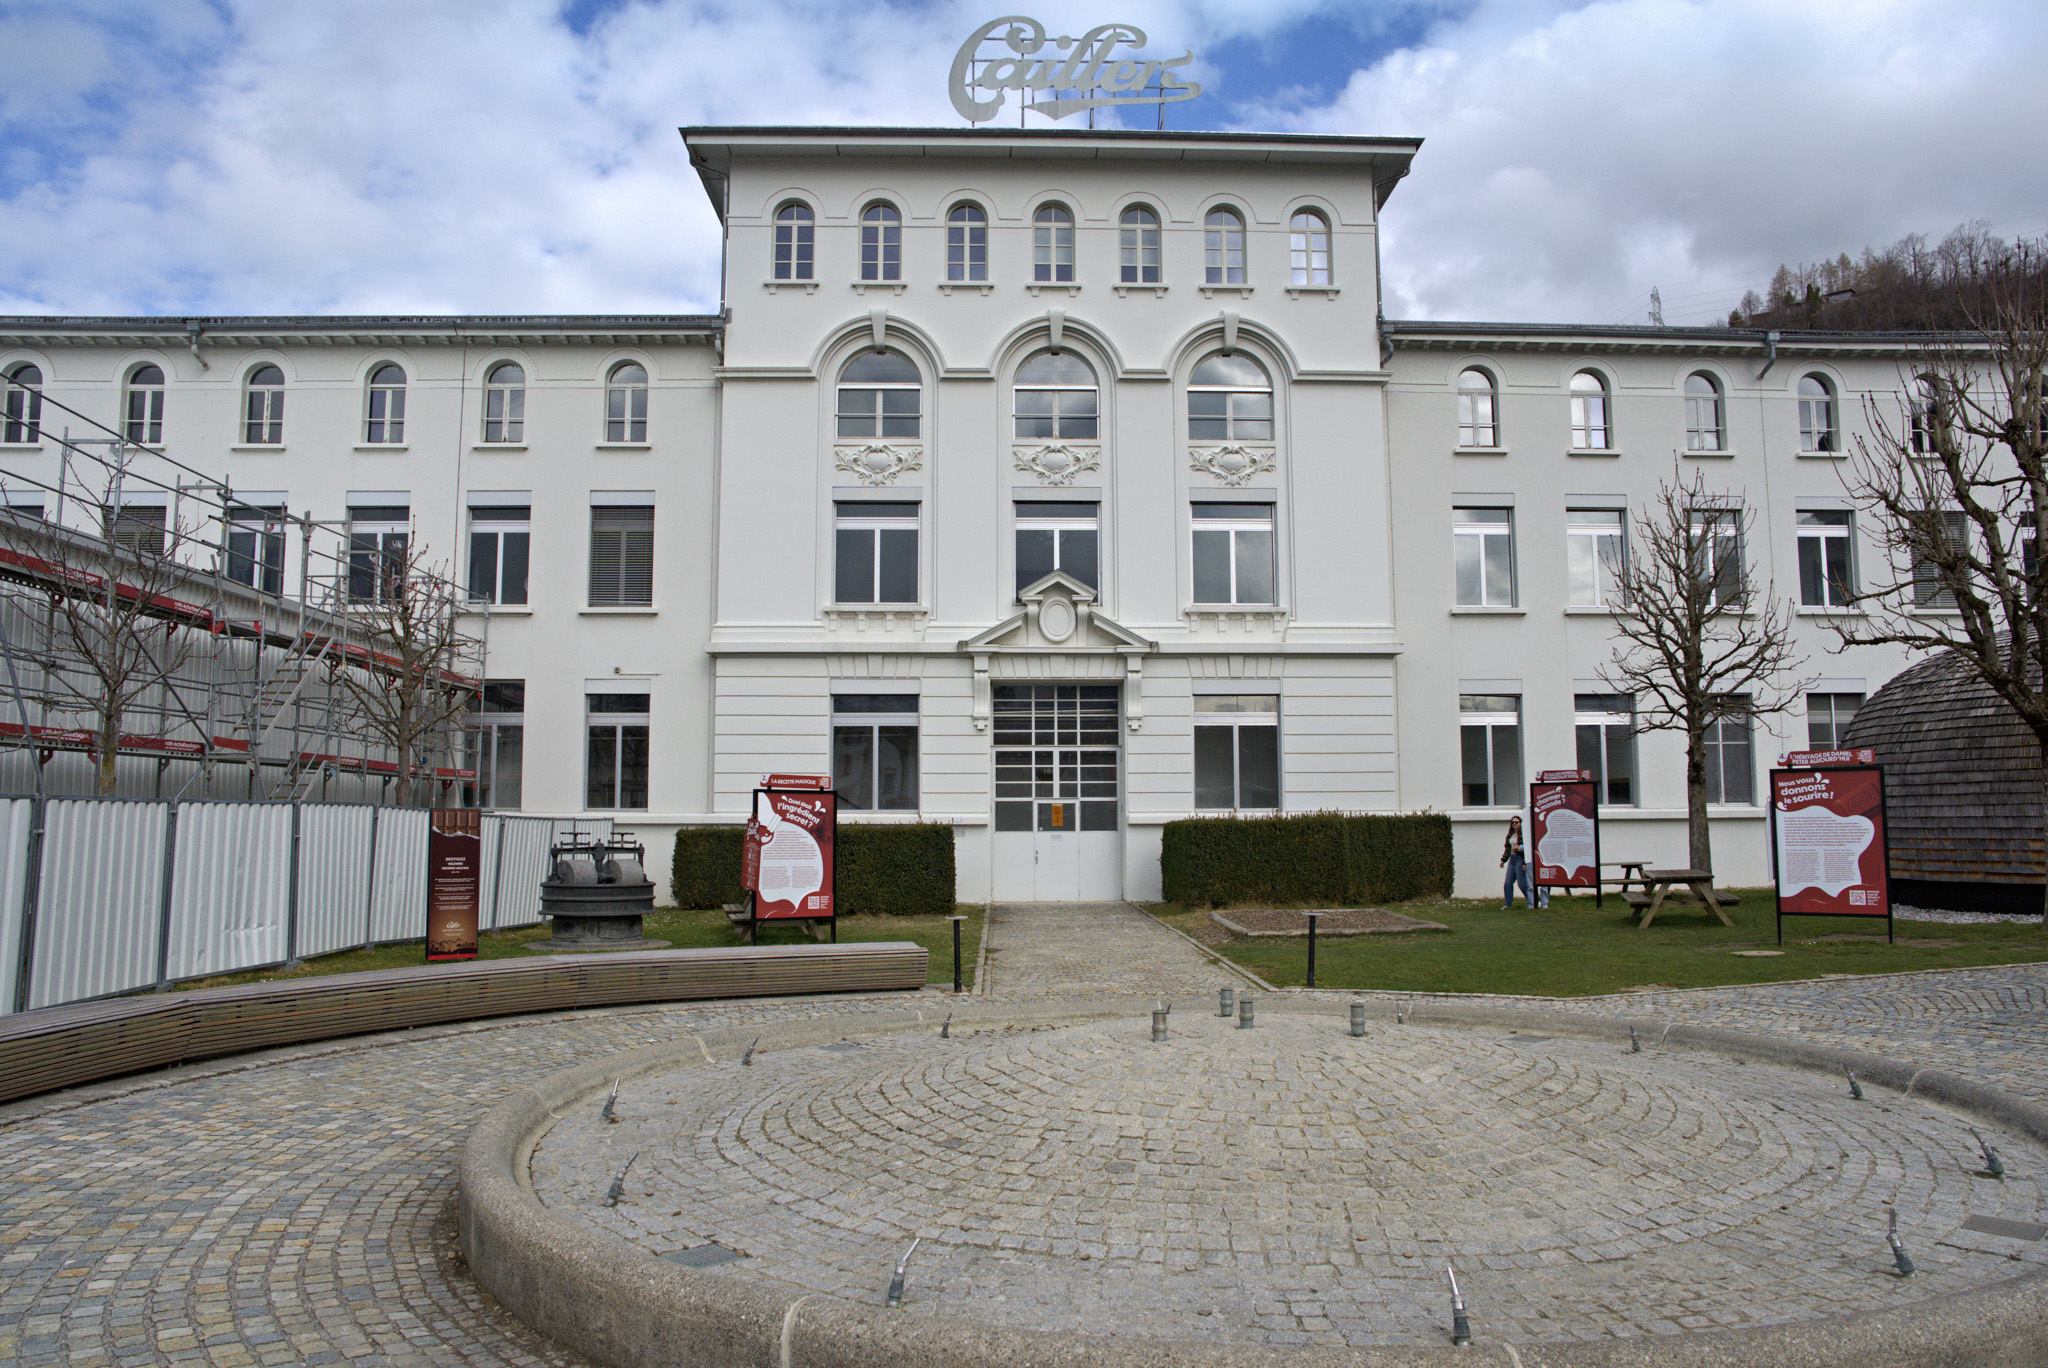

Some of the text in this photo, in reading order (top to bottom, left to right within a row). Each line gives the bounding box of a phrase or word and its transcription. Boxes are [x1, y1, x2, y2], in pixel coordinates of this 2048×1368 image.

[1778, 777, 1815, 788] Nous vous
[1780, 783, 1827, 796] donnons
[1536, 793, 1561, 806] charmer
[1540, 800, 1562, 810] monde
[777, 802, 821, 825] l'ingrédient
[786, 812, 809, 826] secret
